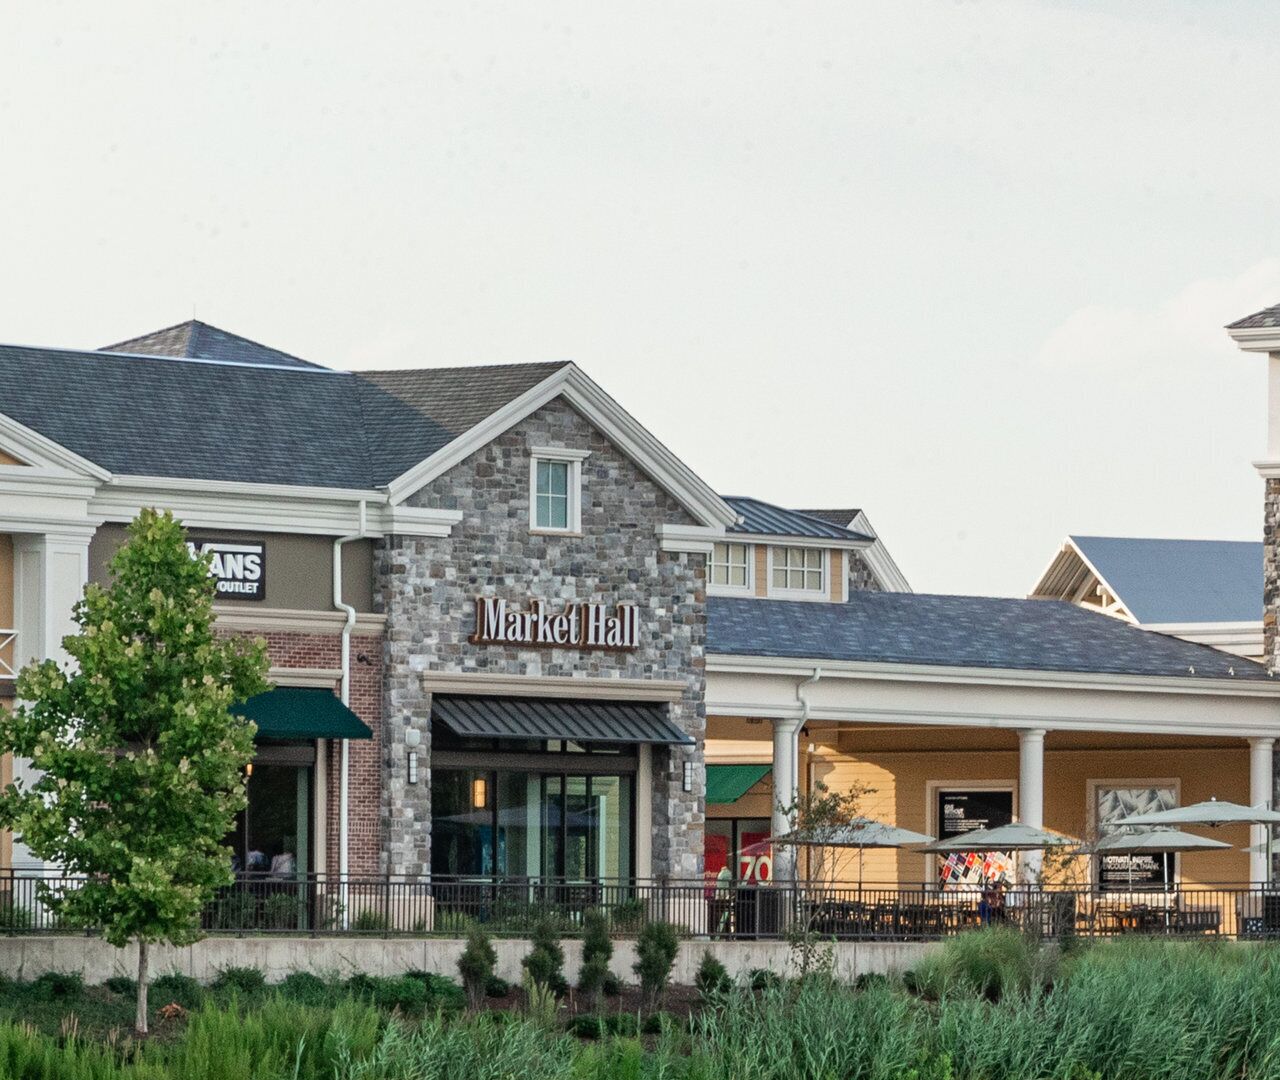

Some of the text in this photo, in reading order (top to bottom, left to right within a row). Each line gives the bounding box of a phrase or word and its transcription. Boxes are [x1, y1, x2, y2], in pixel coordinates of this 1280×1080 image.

[217, 581, 259, 593] OUTLET
[479, 598, 641, 647] Market Hall
[739, 855, 773, 886] 70
